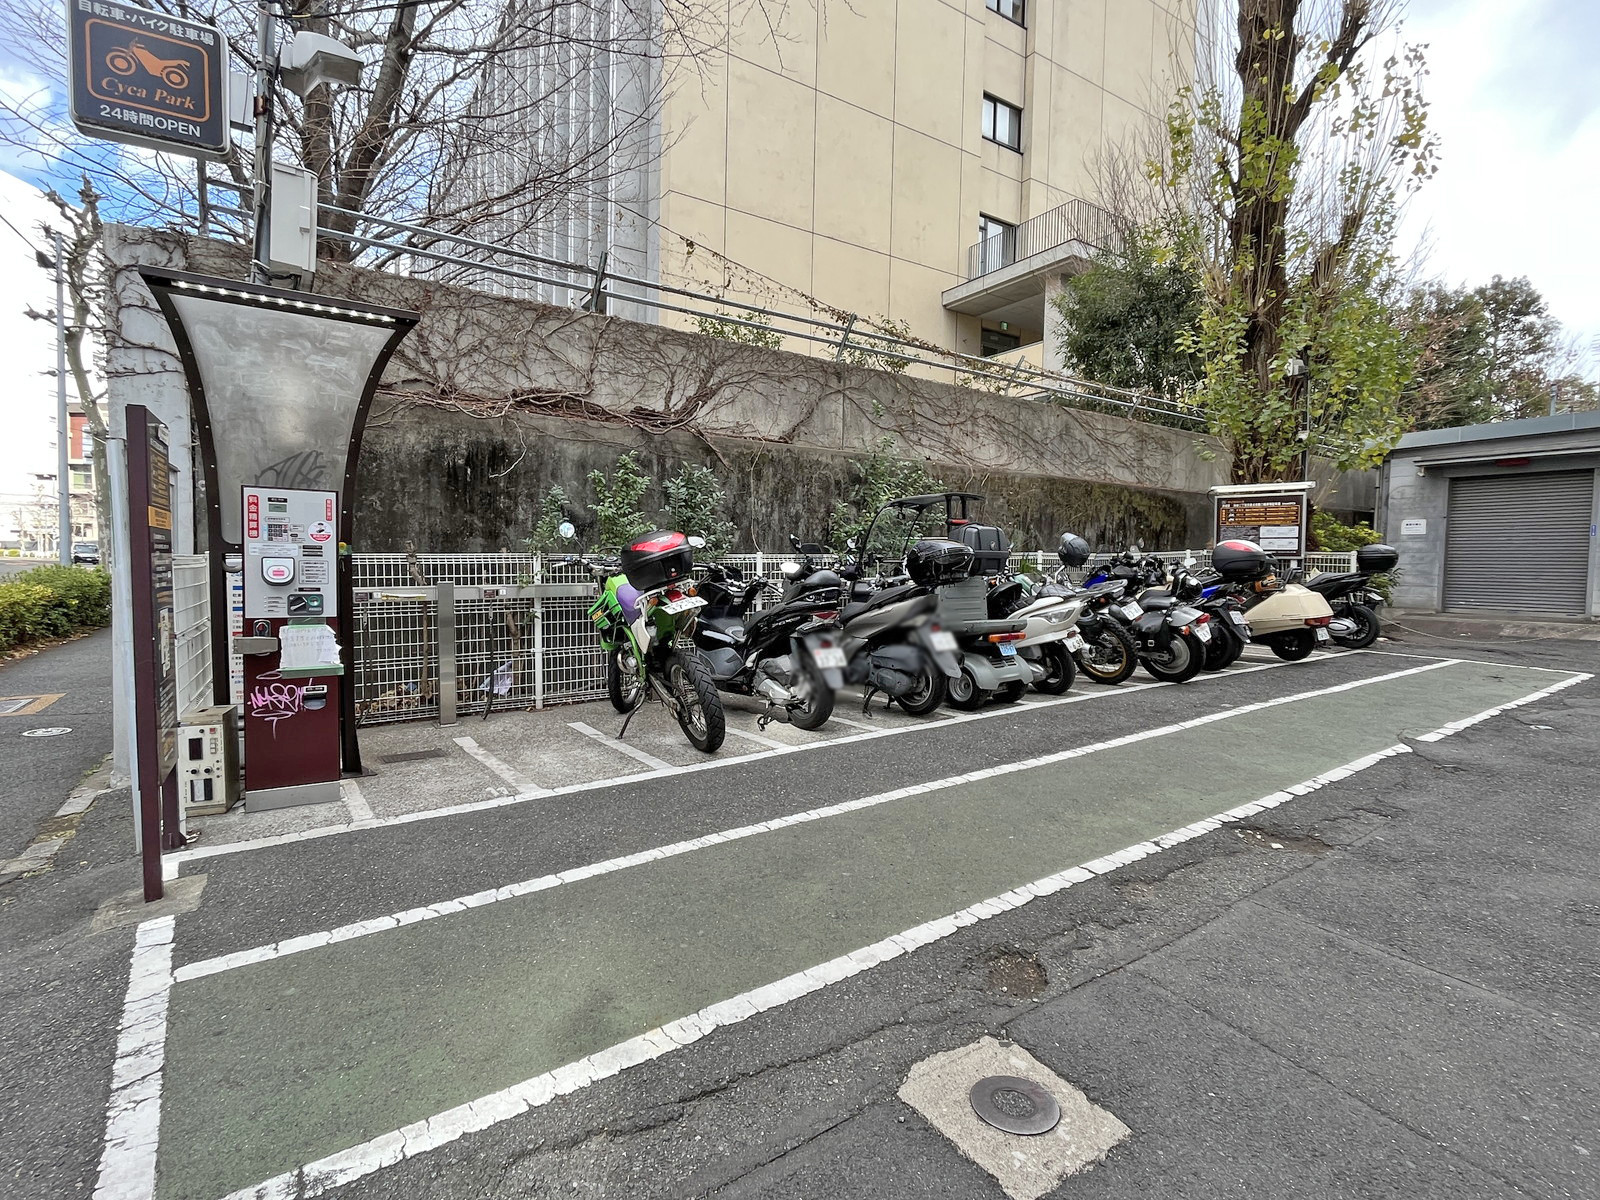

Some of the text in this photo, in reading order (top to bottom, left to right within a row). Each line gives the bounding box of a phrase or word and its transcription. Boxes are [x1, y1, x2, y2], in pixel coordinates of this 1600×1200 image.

[102, 76, 196, 111] Cyca Park
[100, 104, 201, 138] 24時間OPEN
